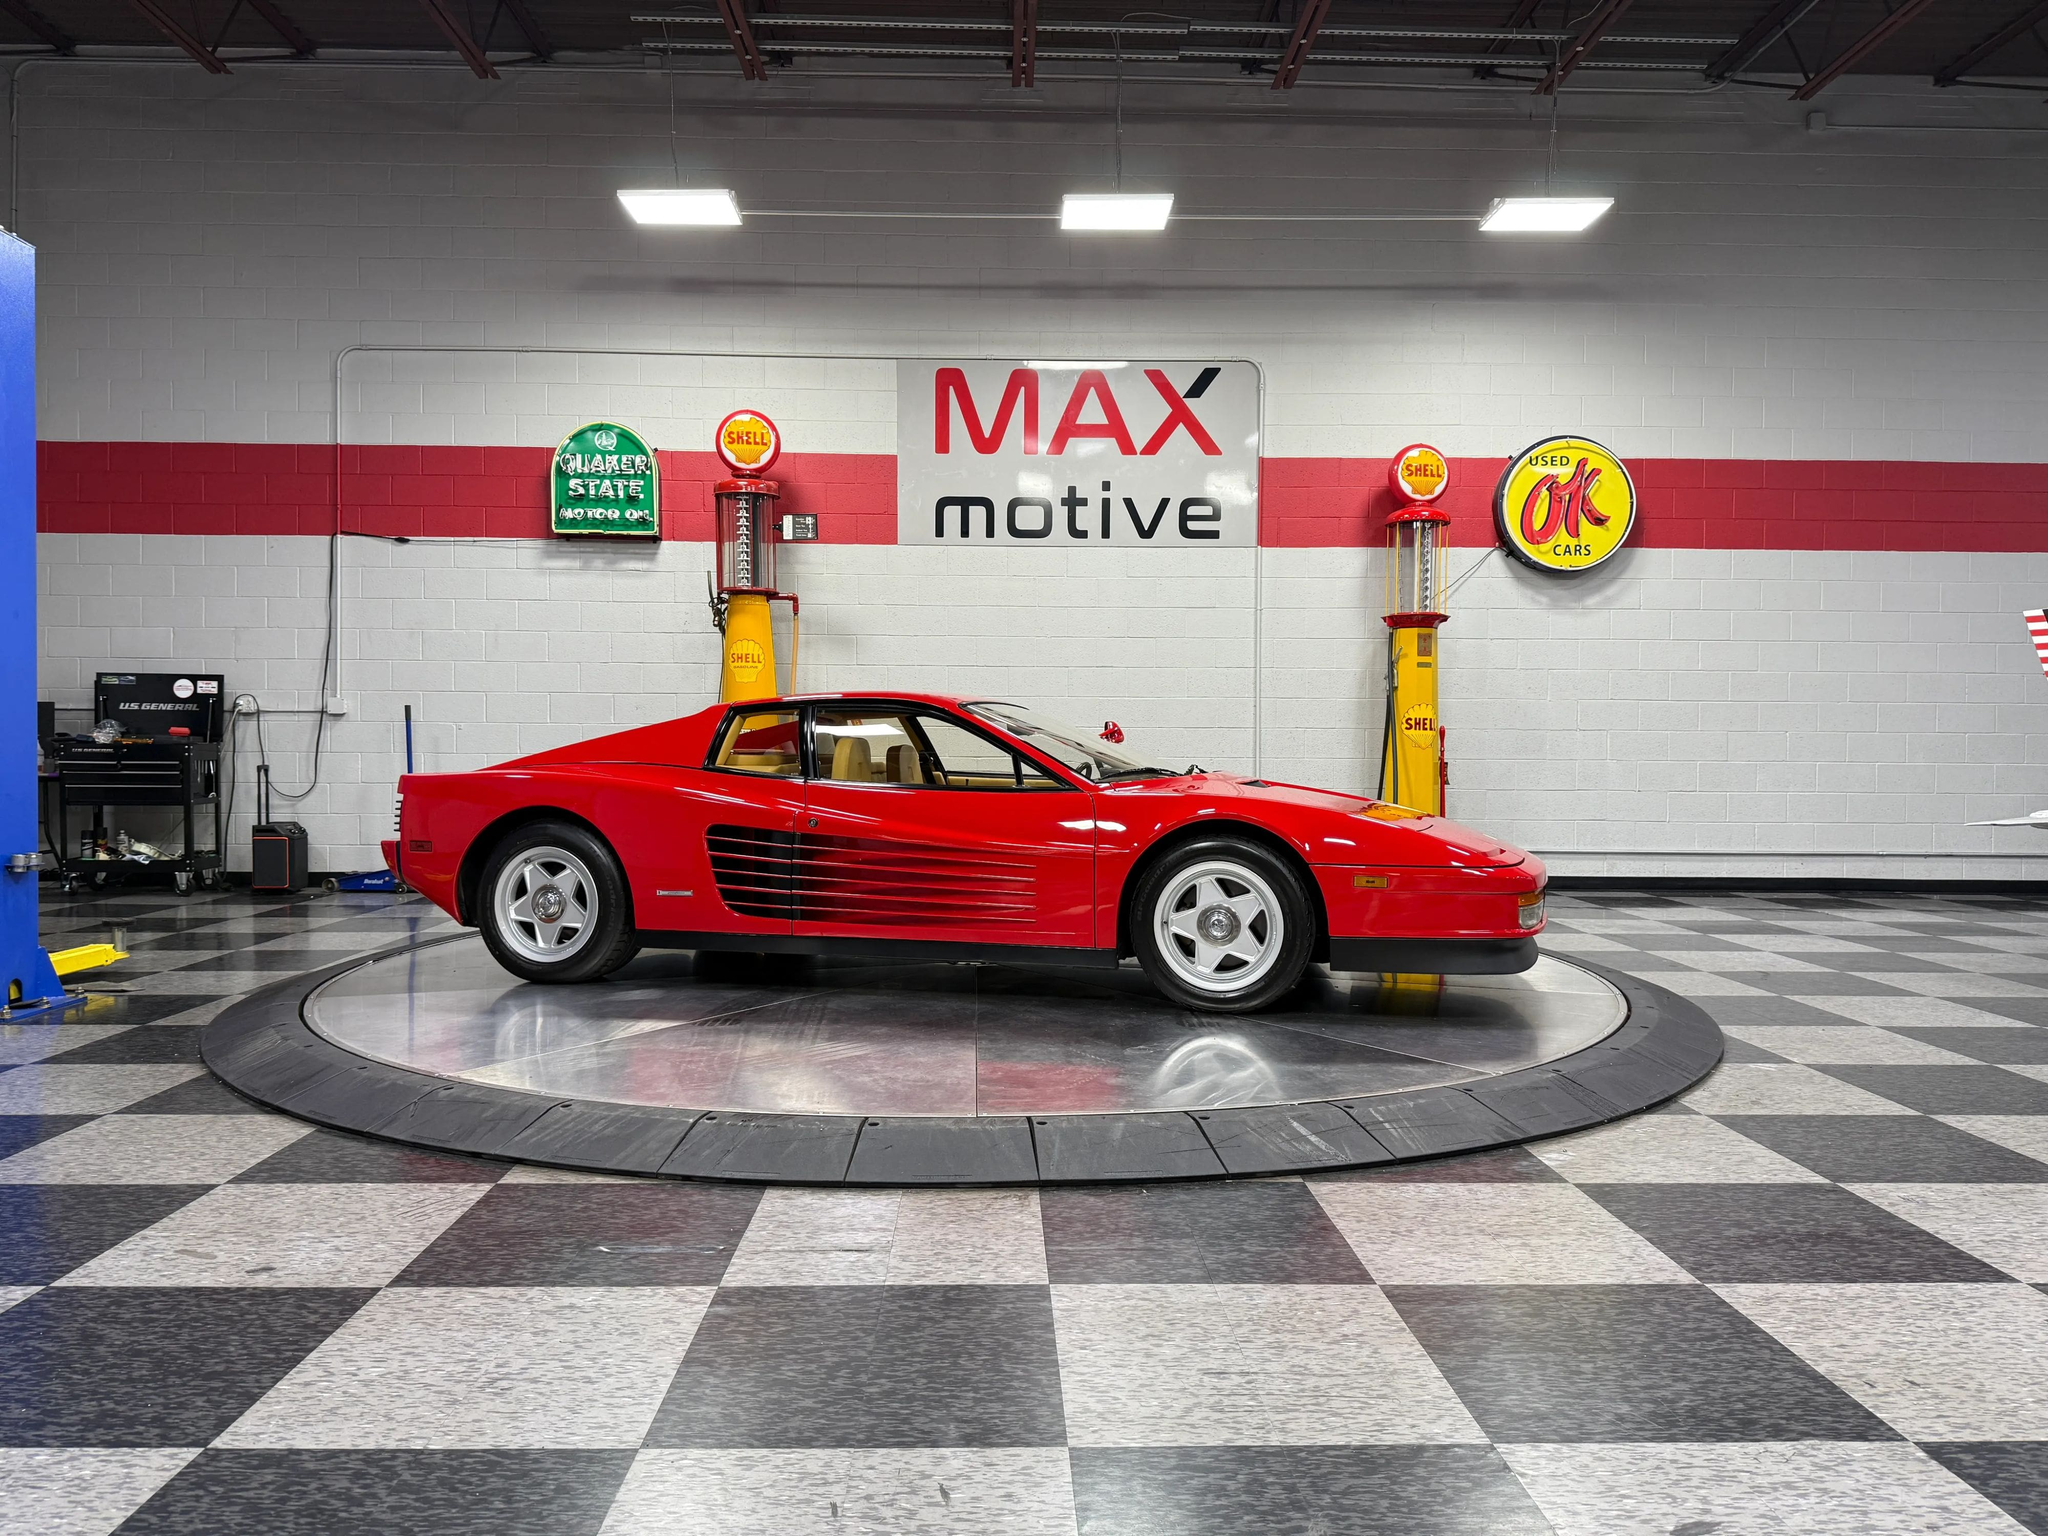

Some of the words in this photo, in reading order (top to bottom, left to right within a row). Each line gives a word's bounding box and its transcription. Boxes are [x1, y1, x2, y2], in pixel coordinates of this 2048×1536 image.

[934, 367, 1223, 456] MAX
[727, 430, 768, 447] SHELL
[559, 453, 652, 476] QUAKER
[1529, 455, 1570, 467] USED
[1405, 463, 1442, 478] SHELL
[568, 478, 645, 499] STATE
[1520, 457, 1612, 546] OK
[559, 507, 621, 520] MOTOR
[624, 508, 654, 522] OIL
[934, 480, 1222, 540] motive
[1553, 544, 1591, 557] CARS
[731, 652, 763, 664] SHELL
[140, 702, 200, 711] GENERAL
